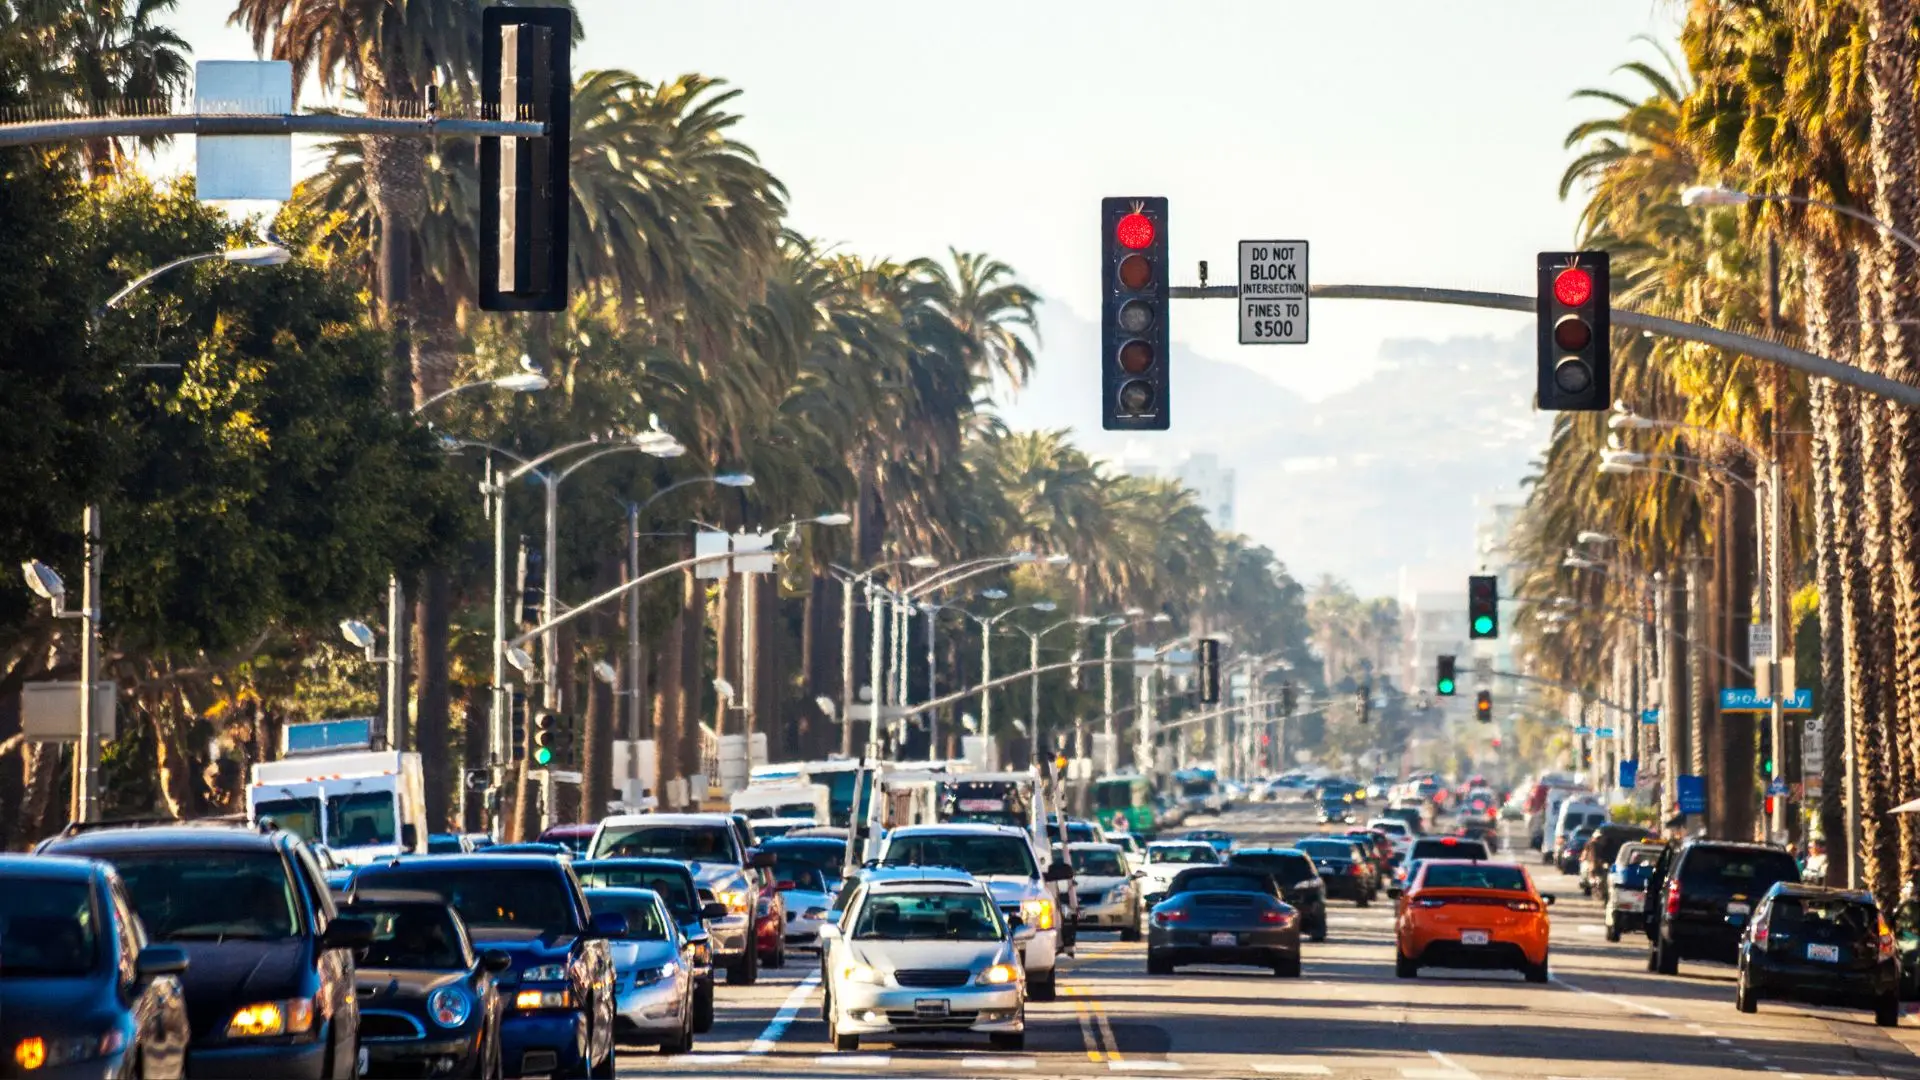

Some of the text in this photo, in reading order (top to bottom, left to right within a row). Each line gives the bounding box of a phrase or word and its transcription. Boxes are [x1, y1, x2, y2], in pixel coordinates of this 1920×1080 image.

[1252, 247, 1295, 260] DO NOT
[1250, 264, 1296, 280] BLOCK
[1243, 283, 1304, 294] INTERSECTION
[1248, 304, 1299, 317] FINES TO
[1254, 320, 1293, 337] $500
[1726, 692, 1806, 708] Broaay
